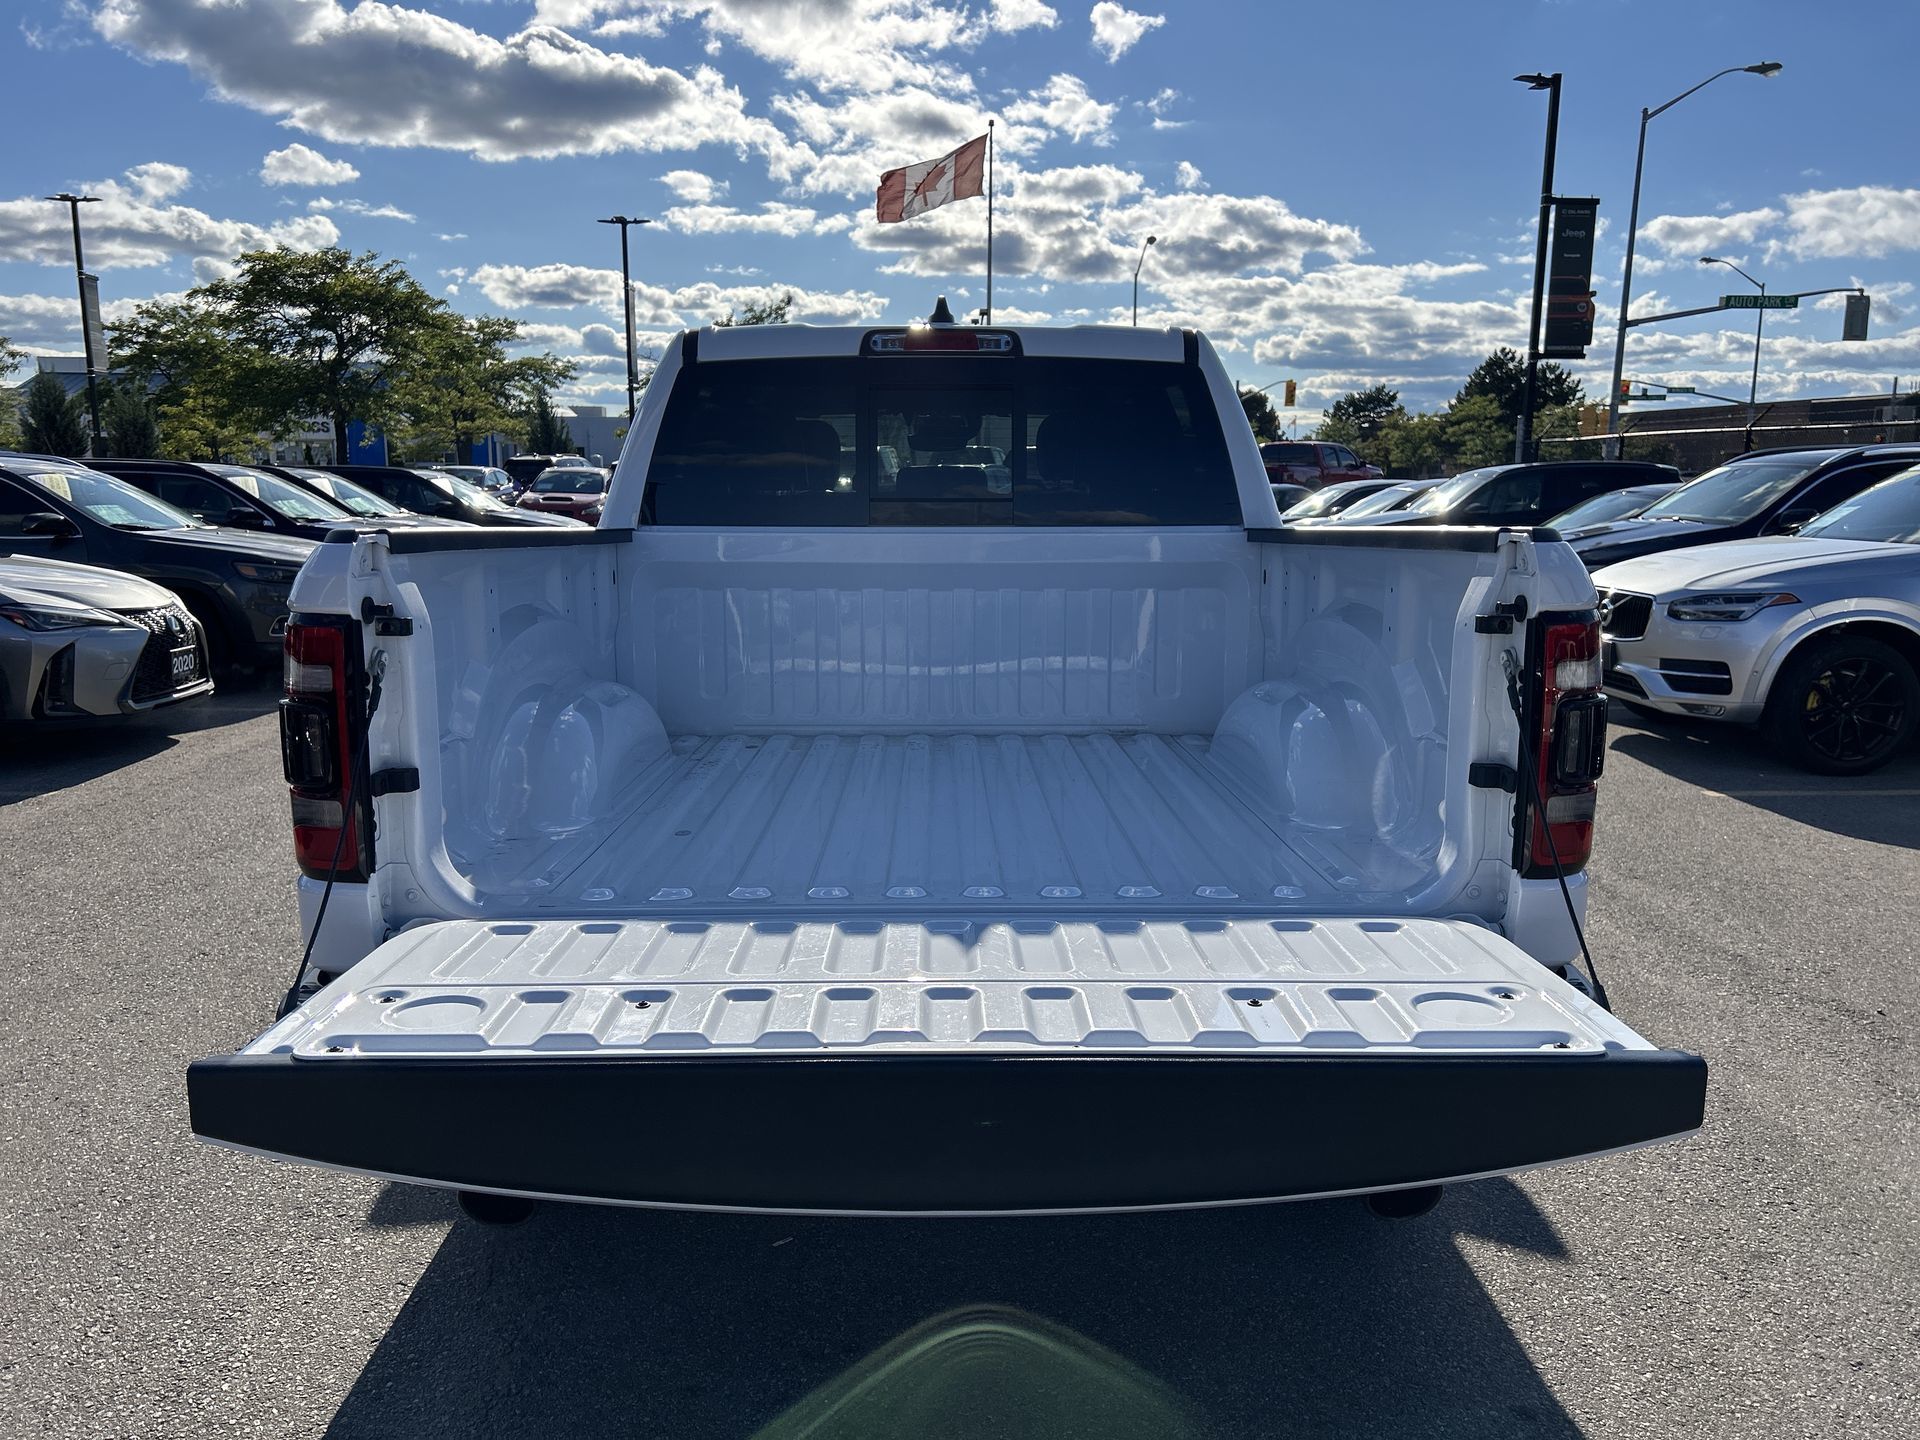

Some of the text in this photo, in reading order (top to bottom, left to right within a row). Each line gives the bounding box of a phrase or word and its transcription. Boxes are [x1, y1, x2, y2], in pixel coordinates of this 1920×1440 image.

[1562, 229, 1586, 239] Jeep
[1729, 296, 1753, 307] AUTO
[1757, 296, 1781, 307] PARK
[173, 654, 194, 674] 2020
